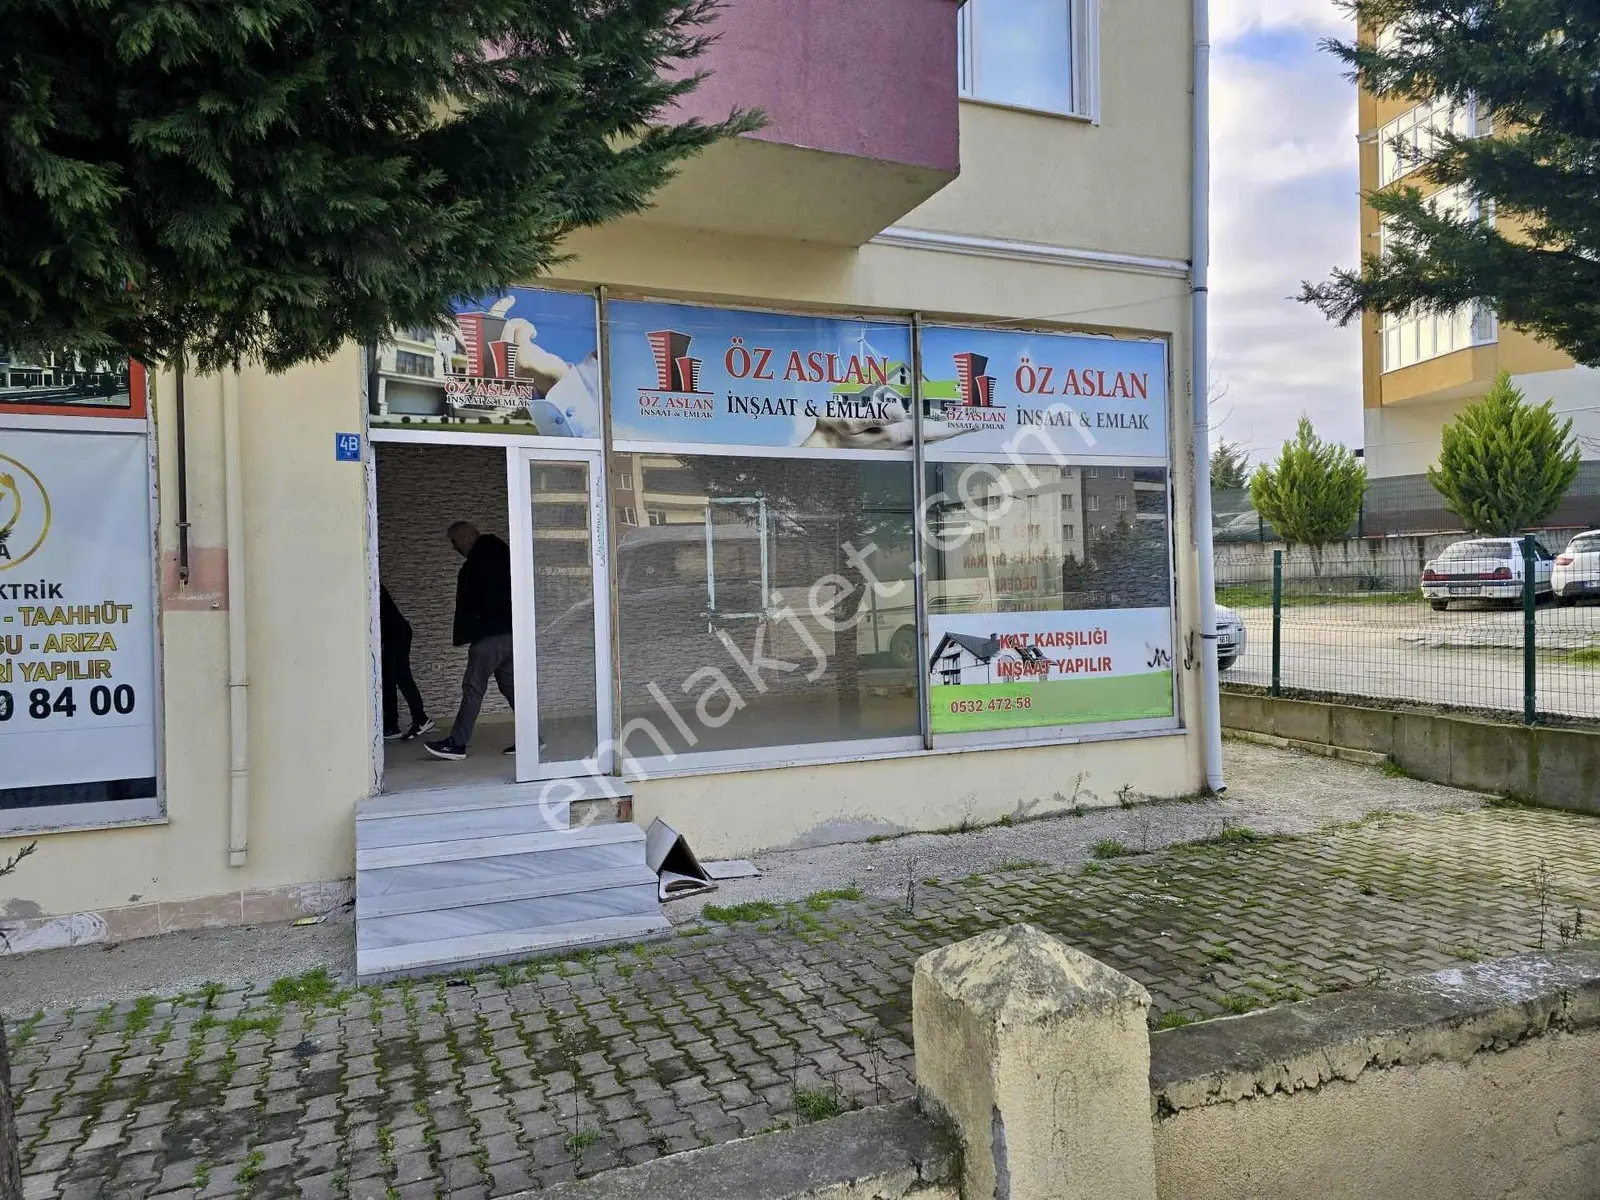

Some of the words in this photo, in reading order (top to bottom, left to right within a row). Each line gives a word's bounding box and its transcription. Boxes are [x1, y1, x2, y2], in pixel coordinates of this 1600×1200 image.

[725, 337, 774, 379] ÖZ
[782, 350, 888, 386] ASLAN
[445, 377, 471, 394] ÖZ
[475, 382, 533, 399] ASLAN
[1016, 357, 1054, 394] ÖZ
[1062, 369, 1148, 399] ASLAN
[639, 392, 660, 407] ÖZ
[665, 397, 713, 410] ASLAN
[727, 390, 798, 419] İNŞAAT
[804, 400, 819, 417] &
[825, 400, 890, 419] EMLAK
[946, 408, 963, 421] ÖZ
[967, 411, 1006, 422] ASLAN
[1017, 405, 1073, 427] İNŞAAT
[1080, 411, 1092, 427] &
[1097, 412, 1149, 430] EMLAK
[340, 436, 358, 451] 4B
[18, 601, 133, 626] TAAHHÜT
[43, 631, 117, 653] ARIZA
[1000, 633, 1030, 649] KAT
[1035, 627, 1108, 650] KARŞILIĞI
[18, 659, 112, 682] YAPILIR
[997, 659, 1051, 680] İNŞAAT
[1057, 656, 1112, 673] YAPILIR
[29, 686, 77, 719] 84
[90, 684, 135, 716] 00
[951, 700, 983, 713] 0532
[988, 698, 1012, 711] 472
[1016, 697, 1031, 709] 58
